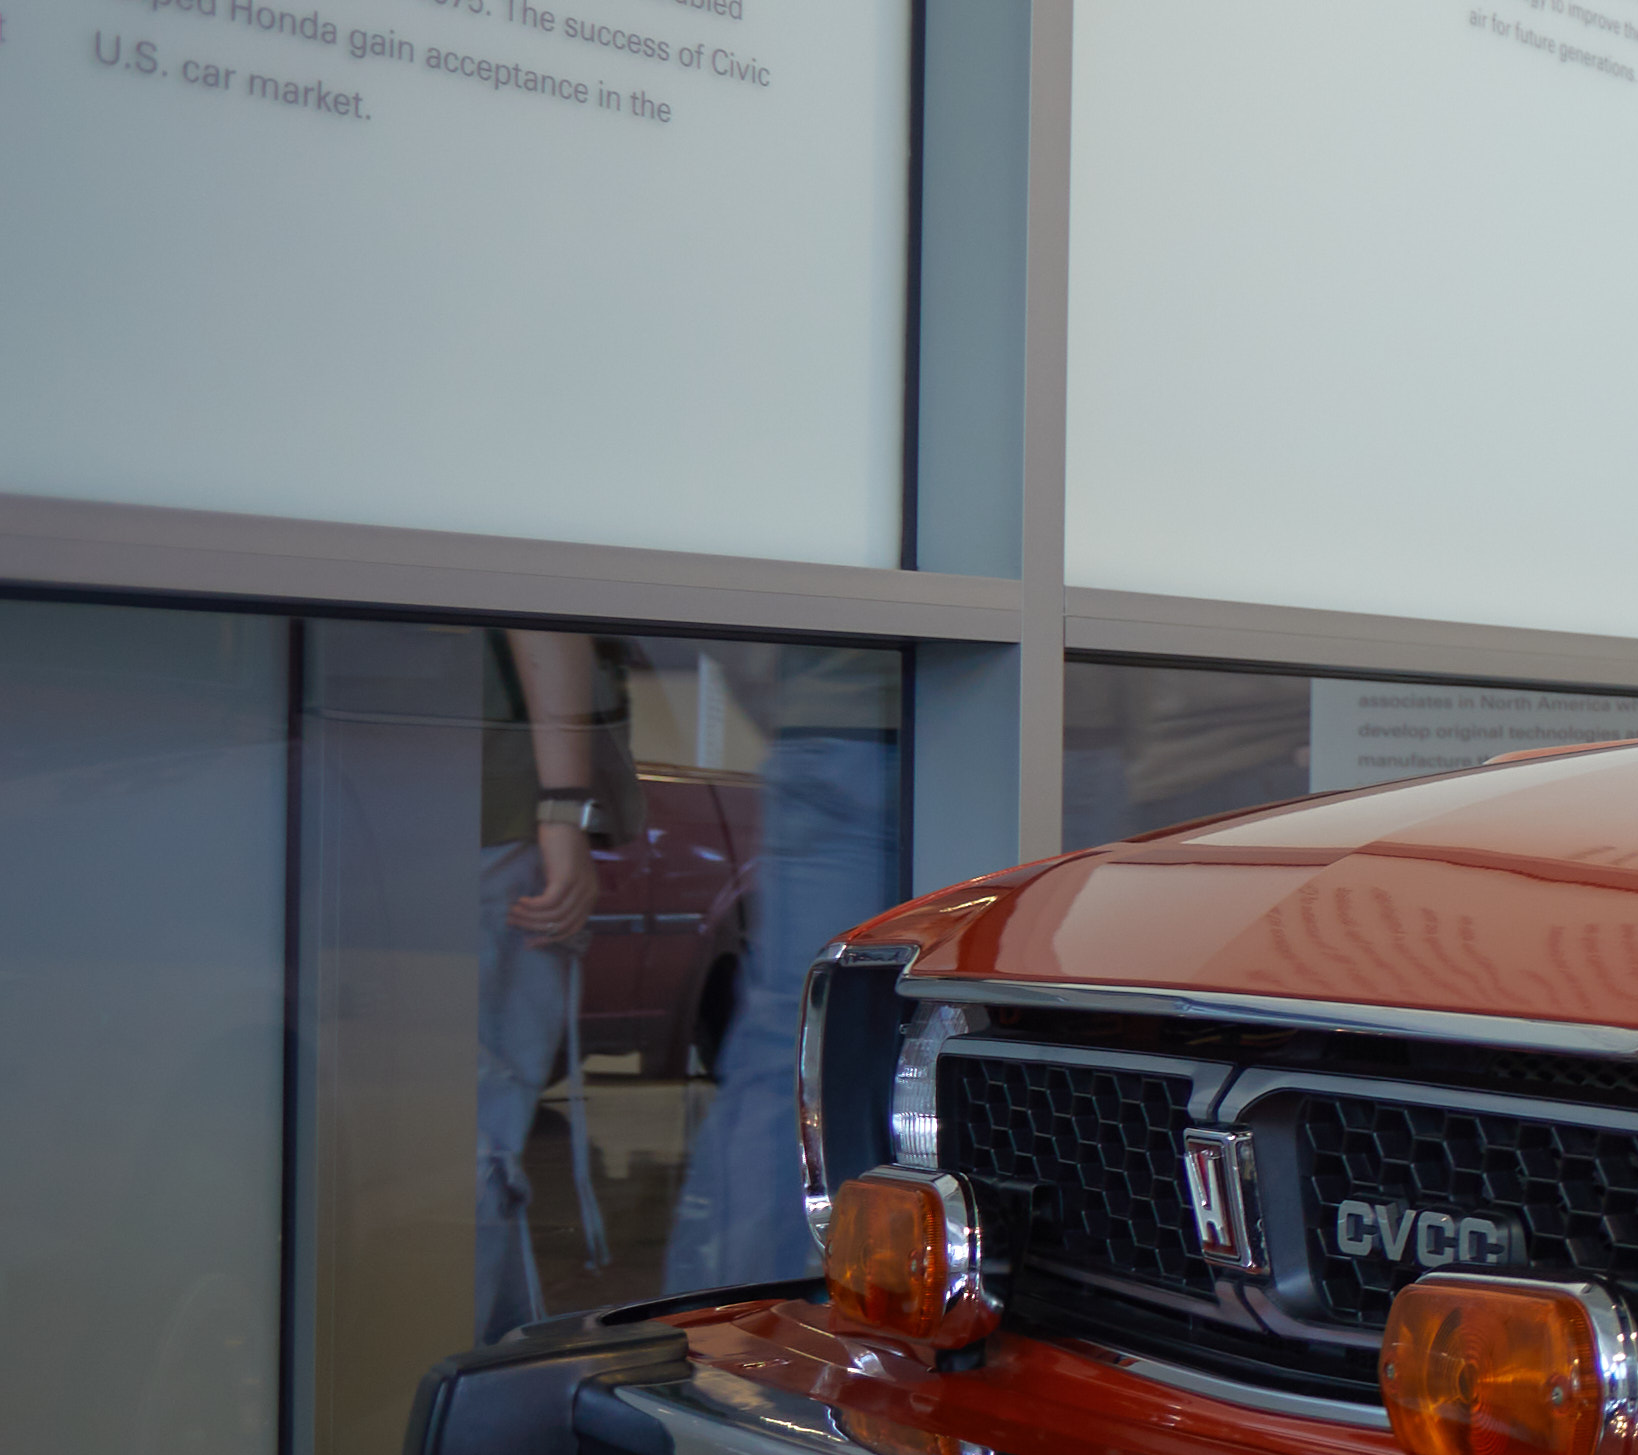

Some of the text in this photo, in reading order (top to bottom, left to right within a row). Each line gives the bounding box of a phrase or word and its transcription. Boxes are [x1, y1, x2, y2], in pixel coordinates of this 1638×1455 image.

[1481, 694, 1531, 712] North
[1537, 696, 1611, 713] America
[1337, 1199, 1498, 1267] CVCC
